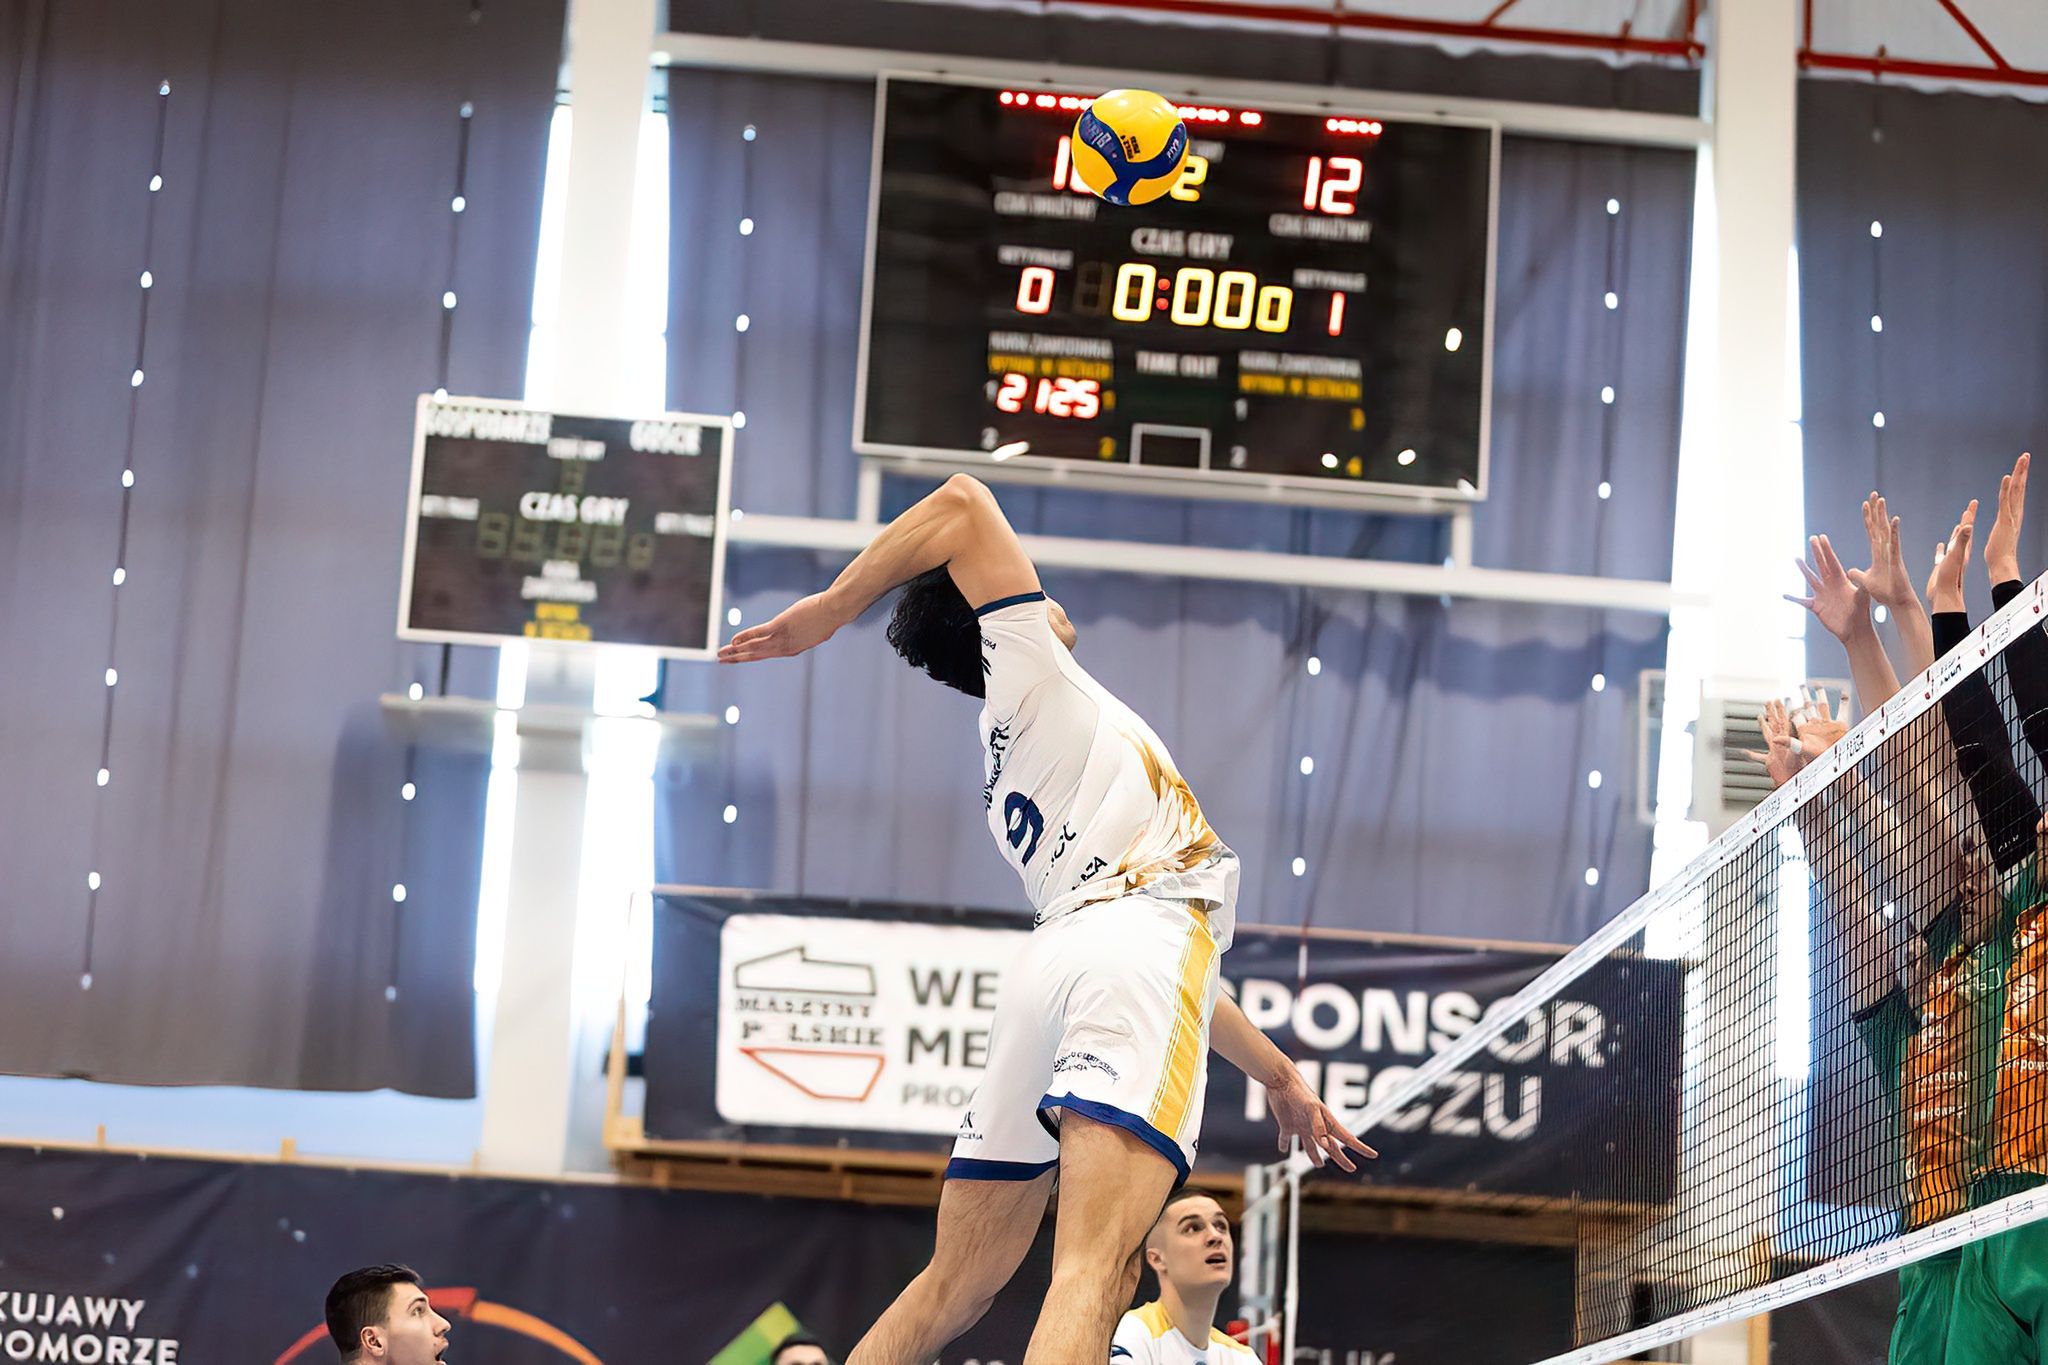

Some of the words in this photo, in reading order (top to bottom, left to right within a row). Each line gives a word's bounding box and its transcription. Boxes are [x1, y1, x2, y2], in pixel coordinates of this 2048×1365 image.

[1303, 155, 1364, 216] 12
[1015, 265, 1056, 316] 0
[1327, 290, 1346, 337] 1
[742, 1020, 884, 1046] PLSKIE
[1219, 976, 1606, 1068] PONSOR
[0, 1329, 179, 1365] OMORZE
